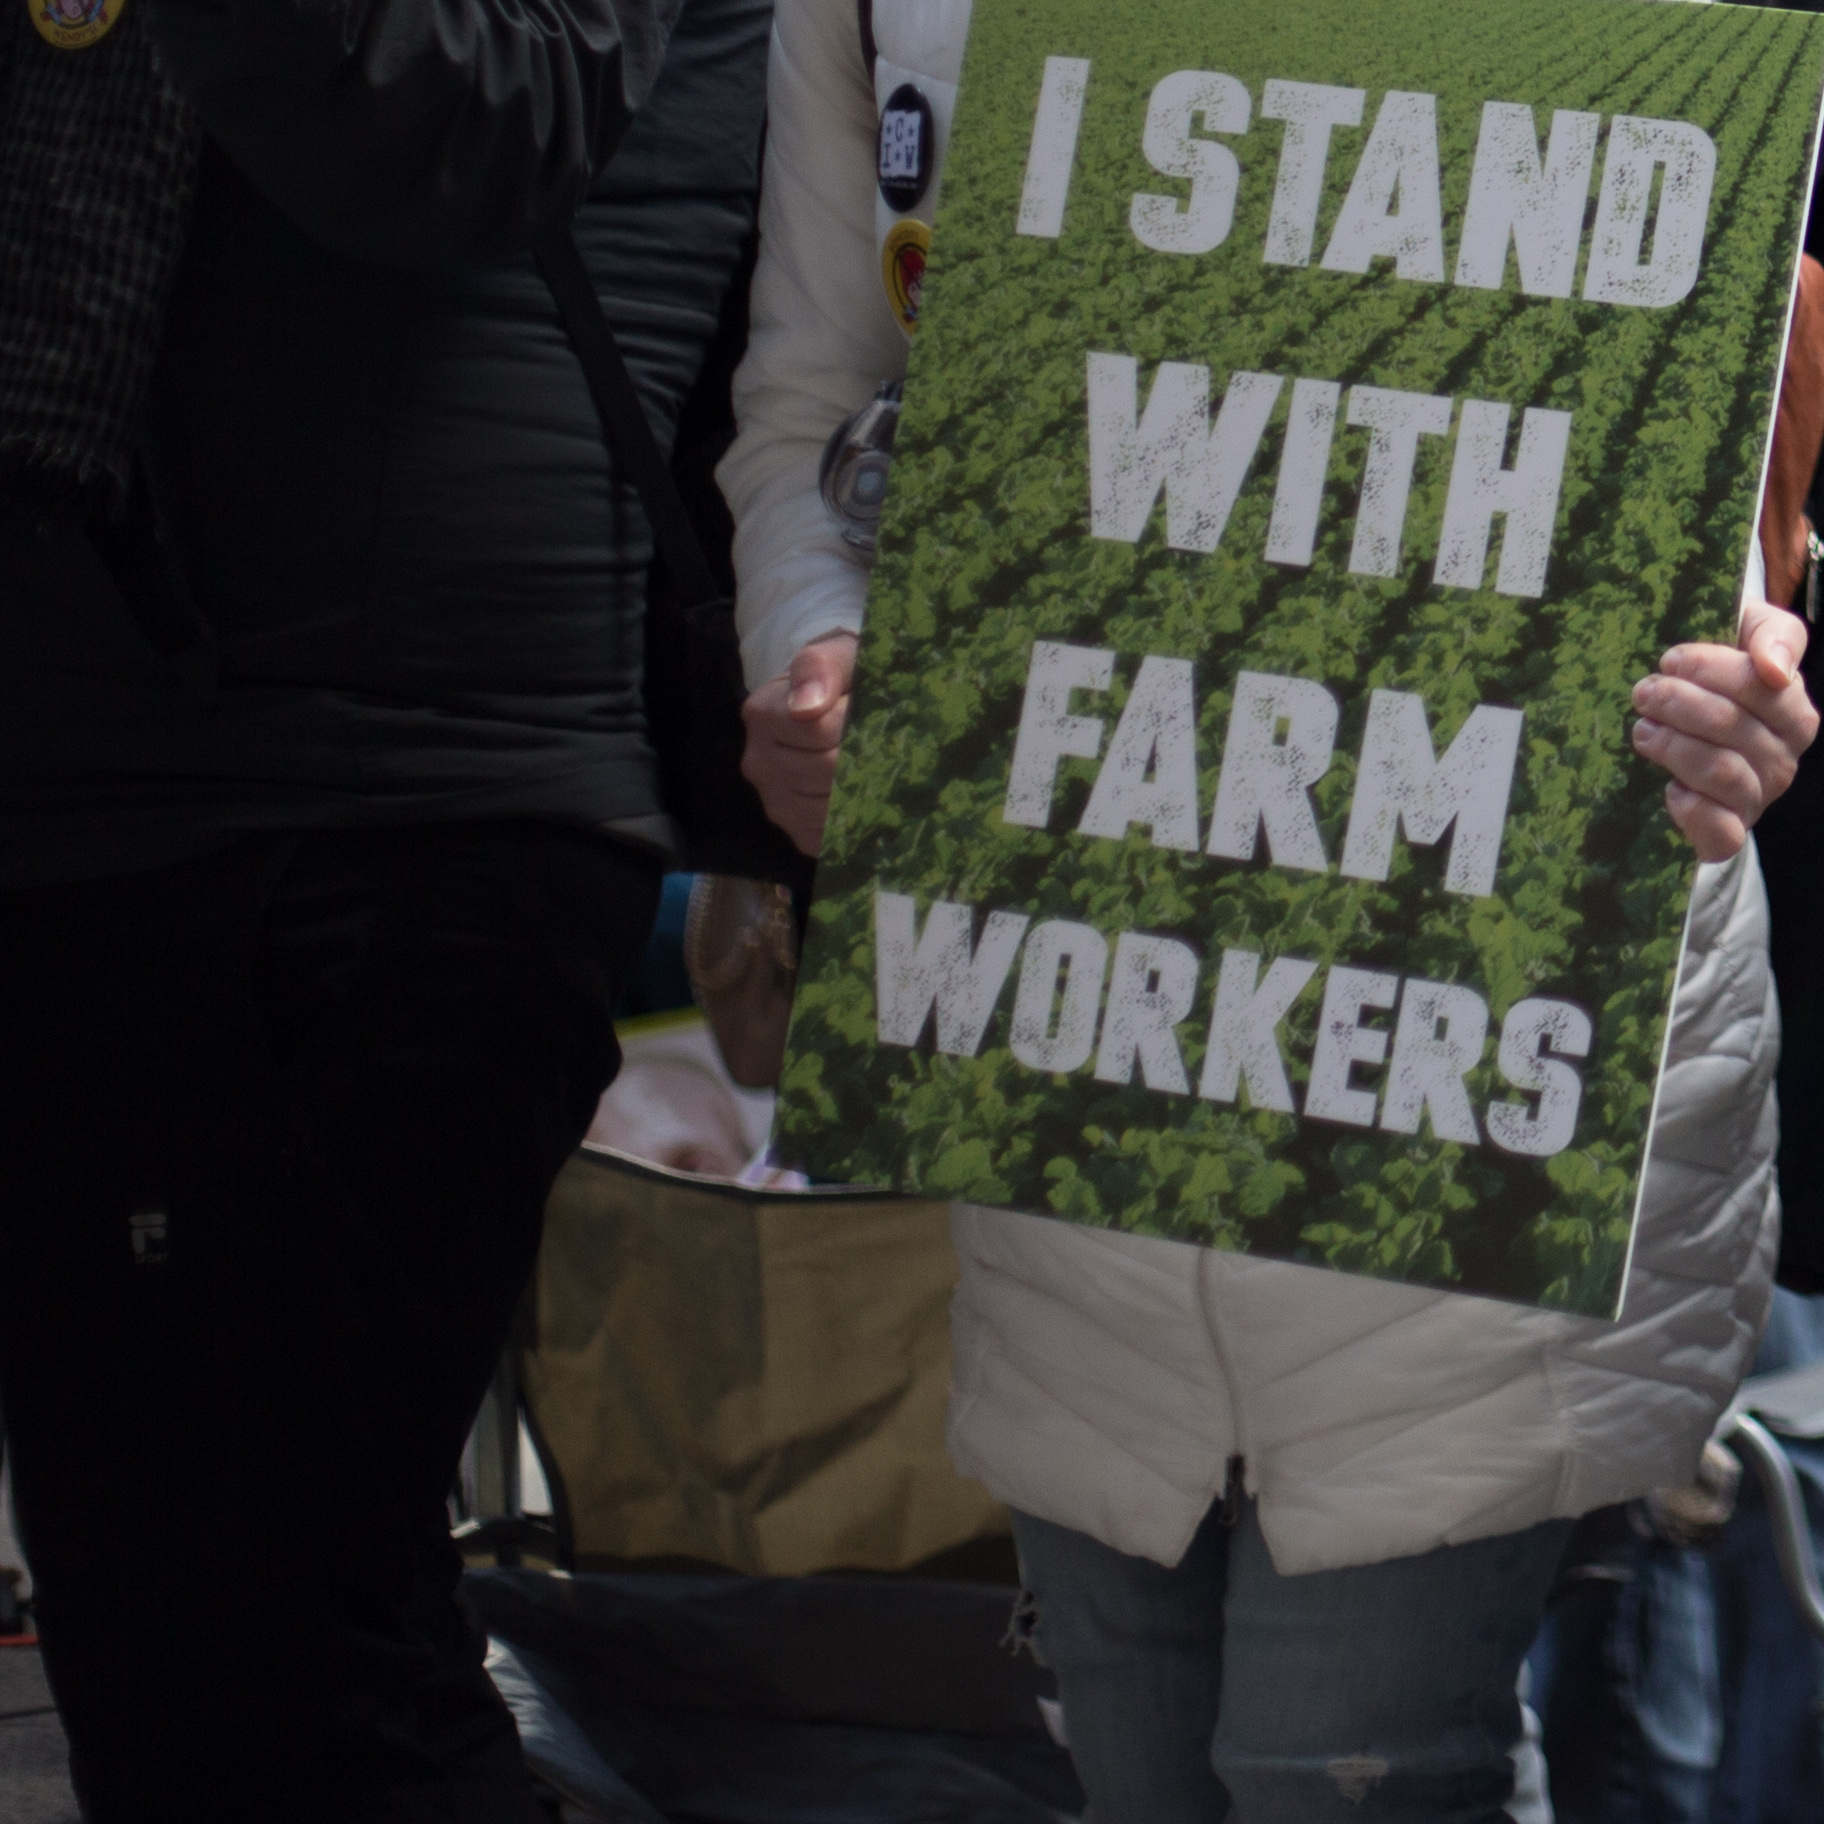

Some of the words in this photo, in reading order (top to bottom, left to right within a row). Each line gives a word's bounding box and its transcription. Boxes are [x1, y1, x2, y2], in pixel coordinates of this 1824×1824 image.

[1015, 54, 1091, 239] I
[1128, 68, 1718, 310] STAND
[1085, 350, 1574, 600] WITH
[1003, 638, 1525, 897] FARM
[874, 889, 1591, 1159] WORKERS
